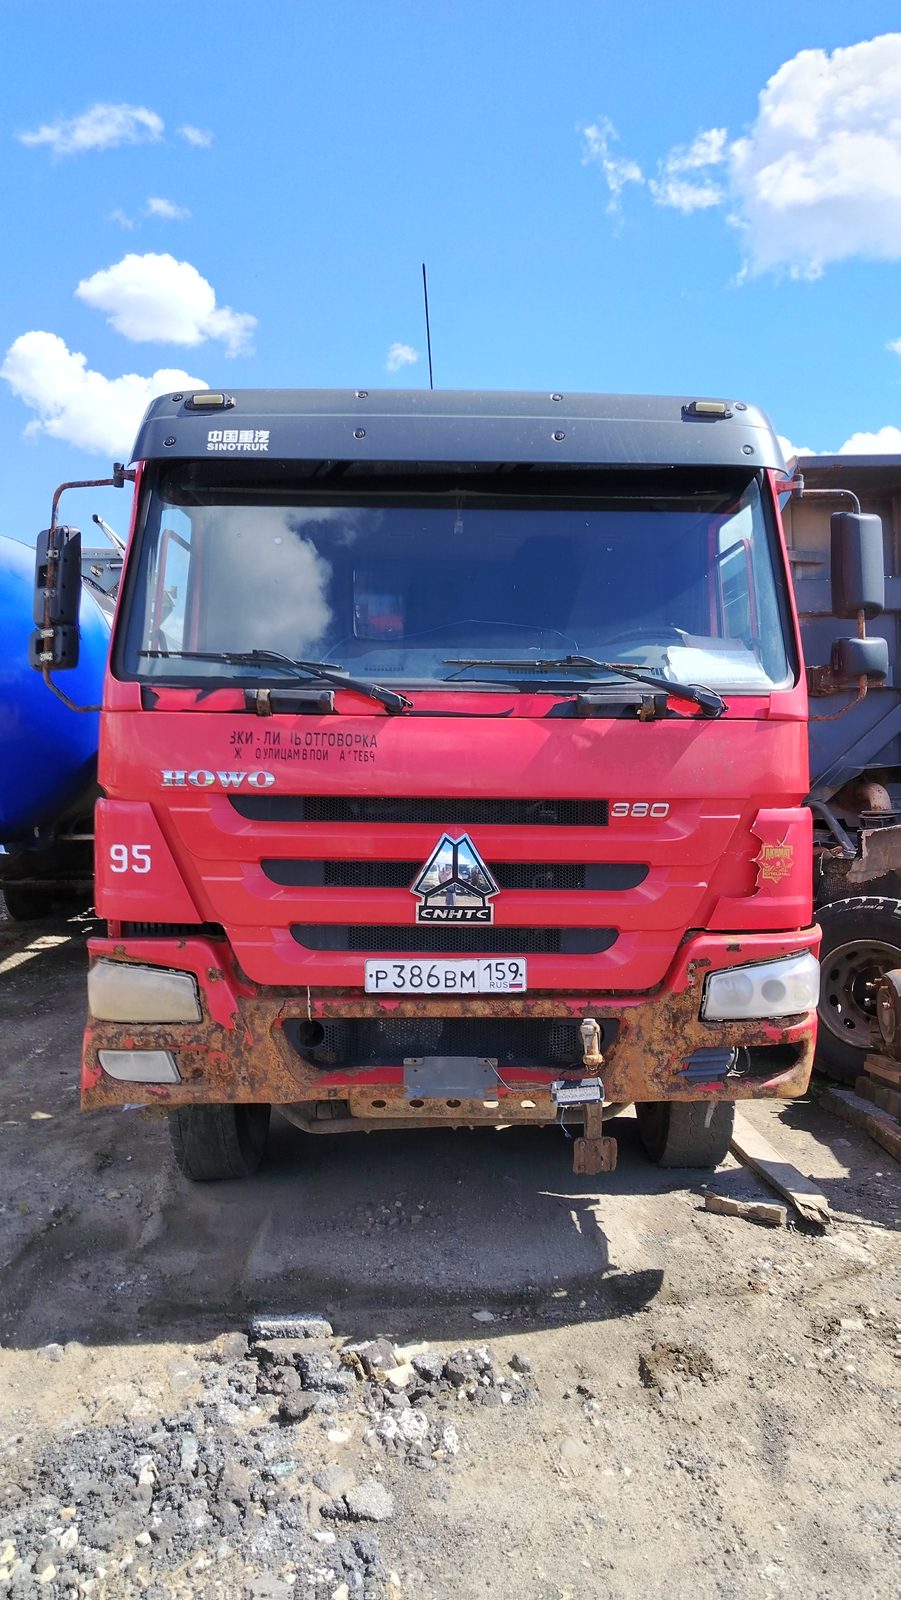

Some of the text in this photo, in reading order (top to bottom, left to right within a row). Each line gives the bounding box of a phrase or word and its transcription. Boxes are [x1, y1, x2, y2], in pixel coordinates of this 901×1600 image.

[207, 430, 270, 443] 中国重汽
[206, 443, 269, 451] SINOTRUK
[304, 732, 378, 748] ОТГОВОРКА
[263, 748, 300, 762] УЛИЦАМ
[161, 770, 276, 788] HOWO
[611, 802, 670, 818] 380
[109, 844, 152, 873] 95
[421, 909, 489, 919] CNHTC
[375, 962, 520, 989] Р386ВМ 159
[489, 981, 509, 989] RUS
